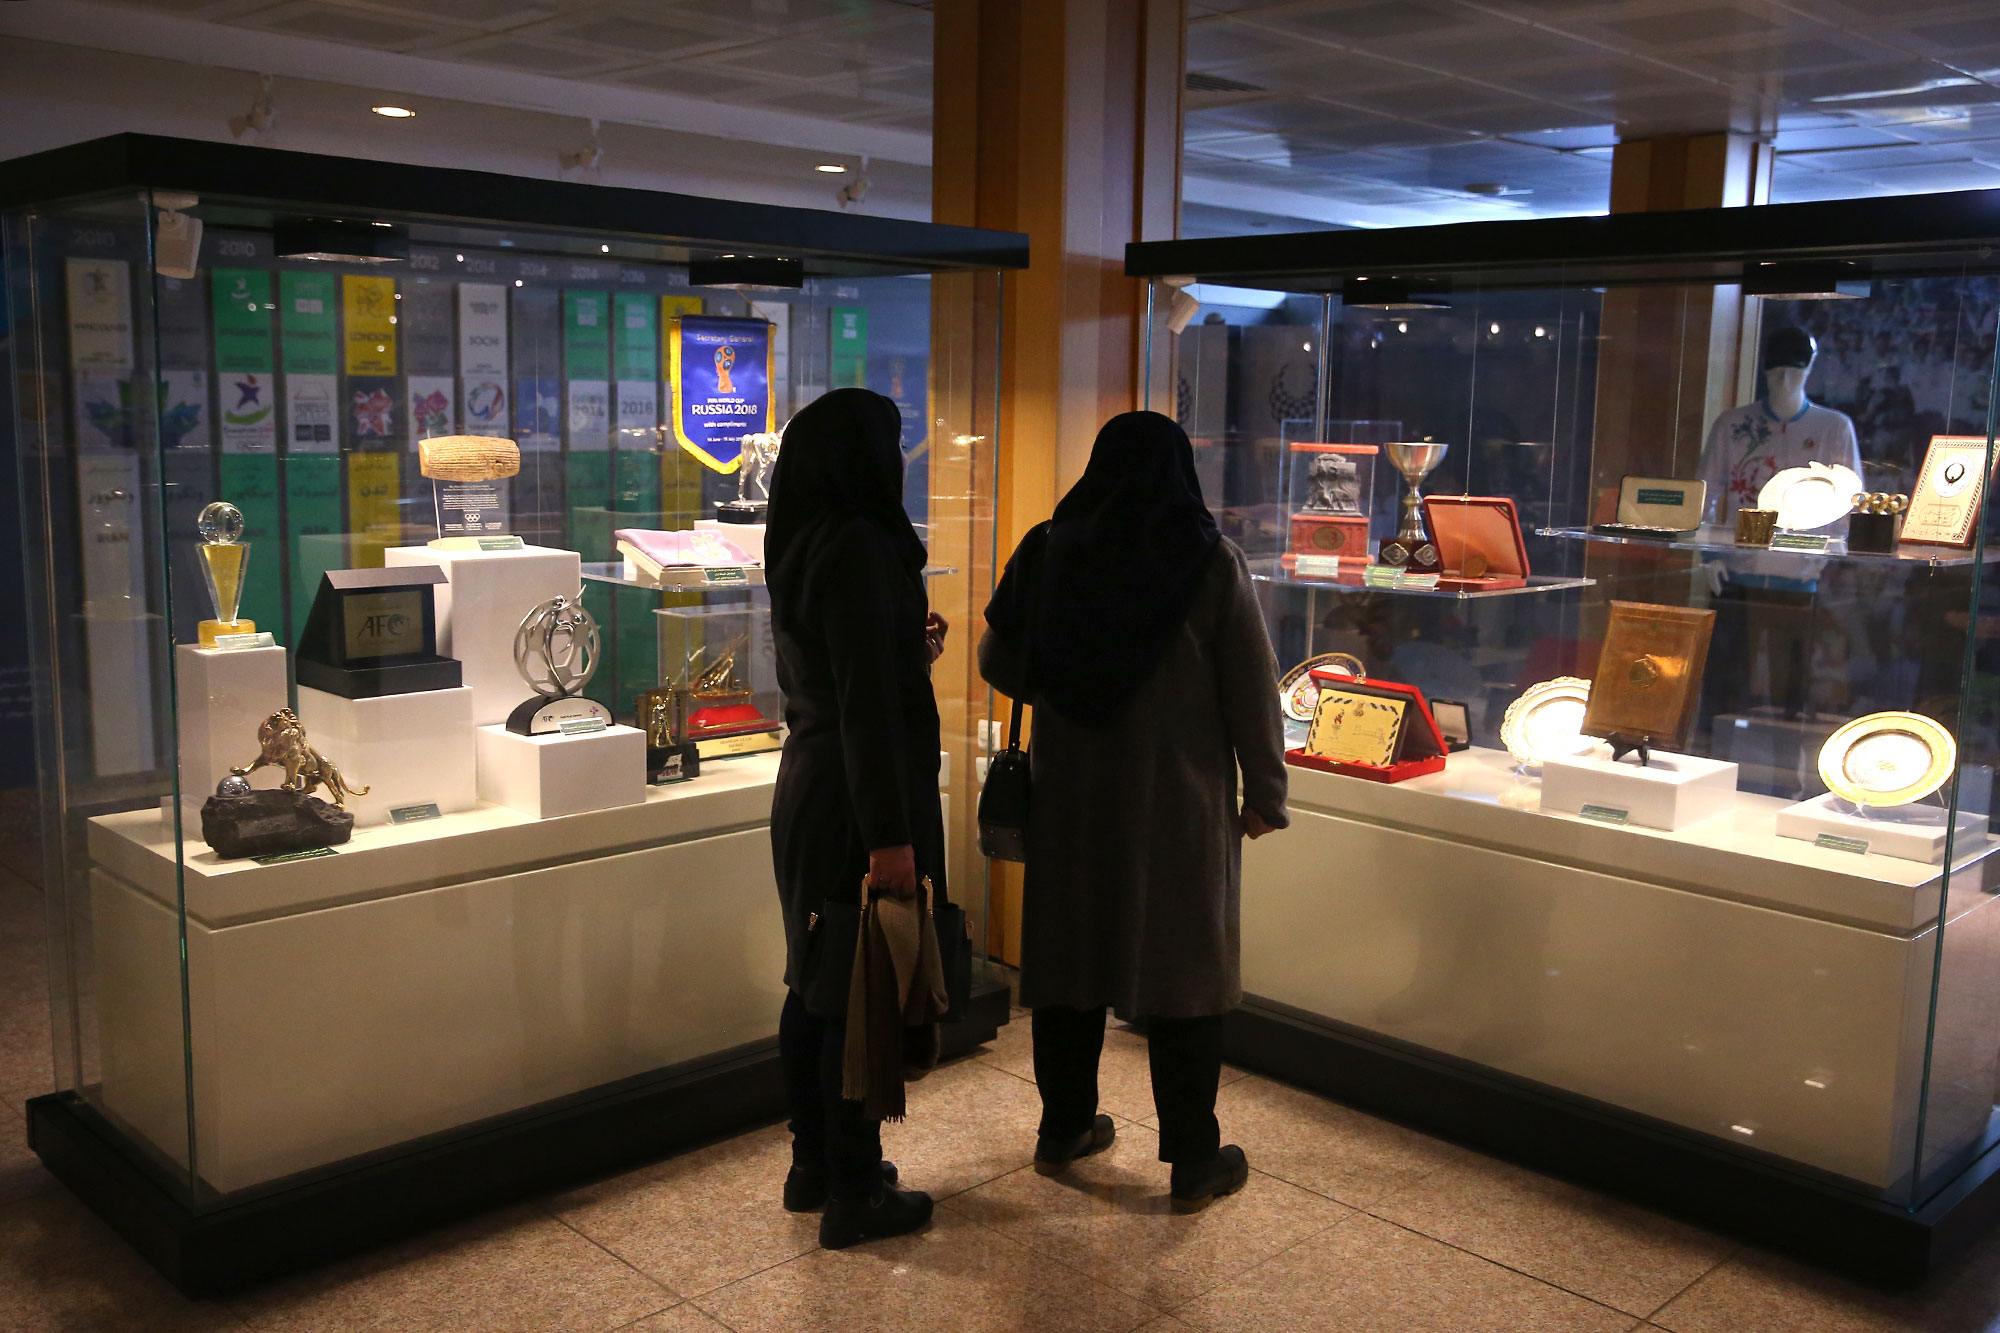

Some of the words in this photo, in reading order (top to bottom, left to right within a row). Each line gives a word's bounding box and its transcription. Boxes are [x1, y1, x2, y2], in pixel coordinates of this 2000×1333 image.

[219, 240, 255, 257] 2010
[696, 333, 727, 344] Secretary
[729, 334, 754, 343] General
[621, 401, 654, 415] 2016
[692, 404, 733, 415] RUSSIA
[734, 404, 758, 415] 2018
[356, 613, 410, 641] AFC
